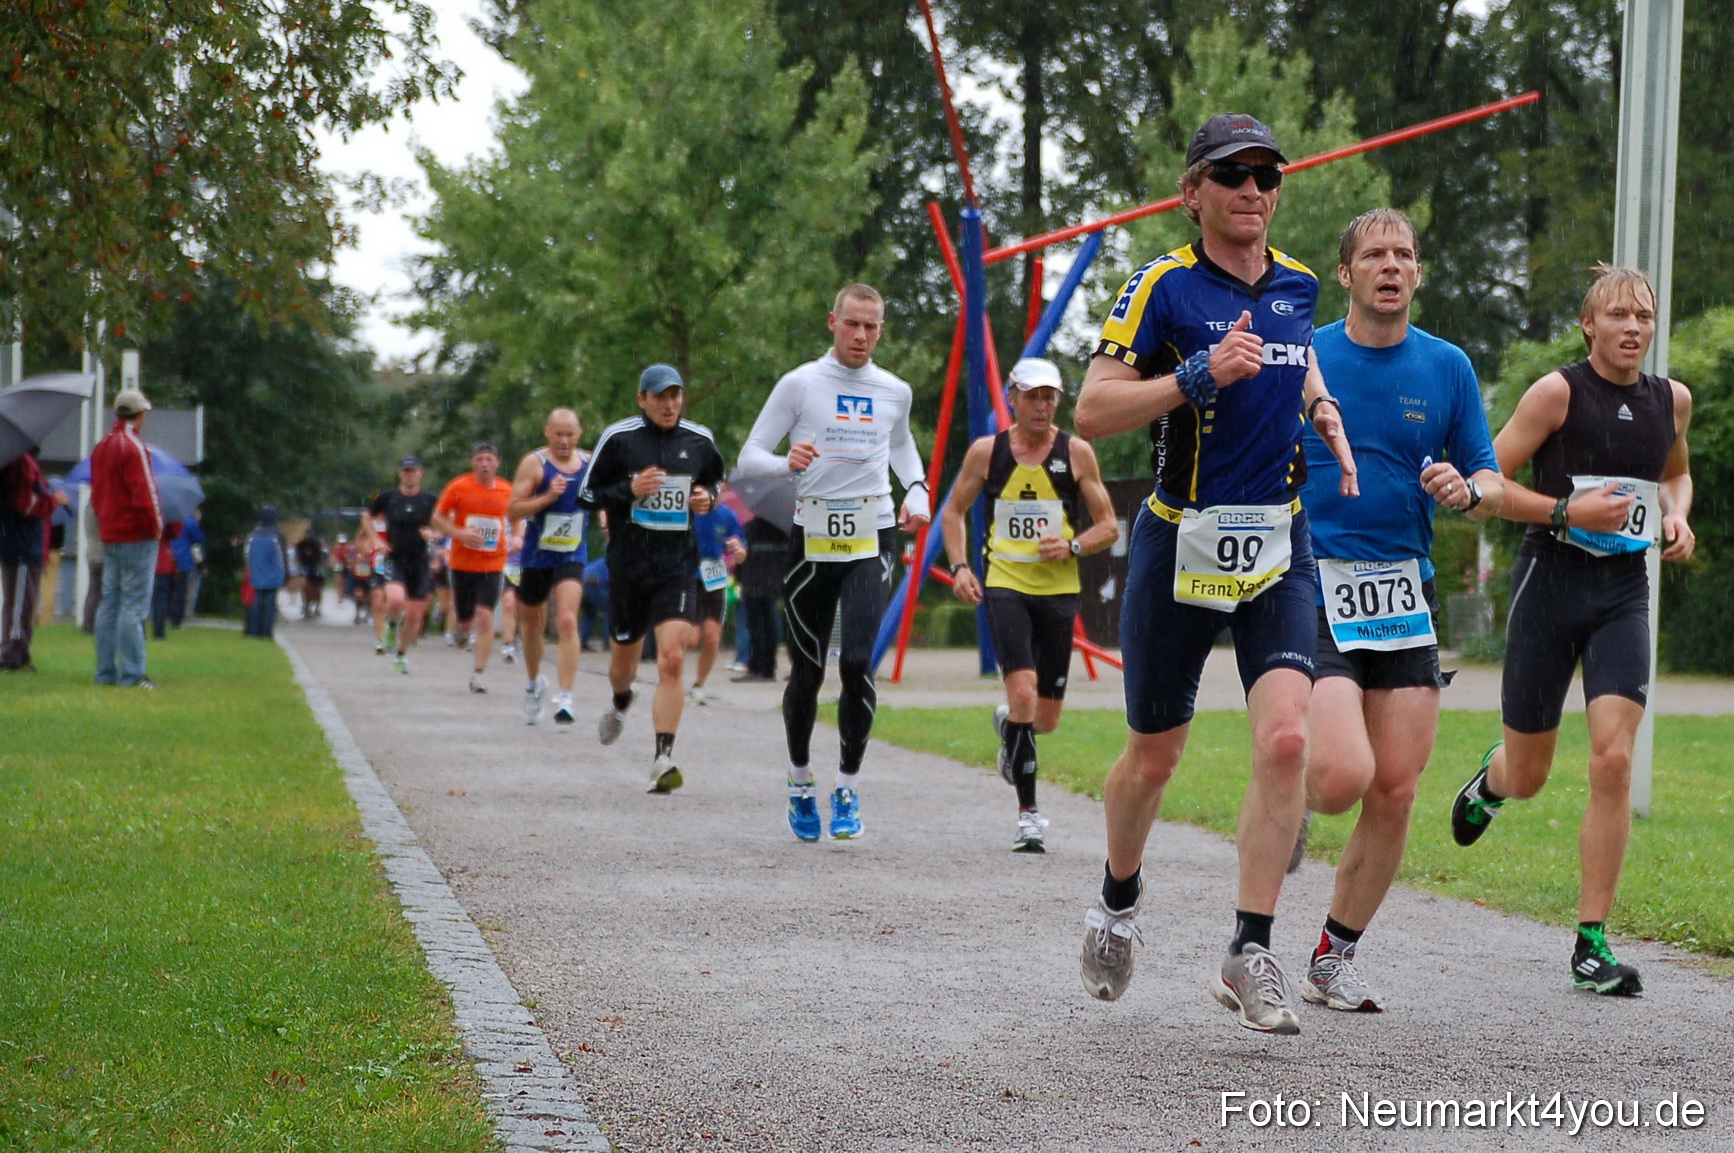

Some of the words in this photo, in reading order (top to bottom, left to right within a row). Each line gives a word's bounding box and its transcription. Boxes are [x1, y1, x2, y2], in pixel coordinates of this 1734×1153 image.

[1399, 396, 1420, 406] TEAM
[826, 427, 877, 436] Raiffeisenbank
[827, 514, 856, 537] 65
[1218, 512, 1265, 524] BOCK
[830, 542, 852, 554] Andy
[1217, 535, 1264, 573] 99
[1354, 561, 1392, 572] BOCK
[1191, 579, 1233, 597] Franz
[1335, 576, 1416, 619] 3073
[1357, 620, 1411, 639] Michael
